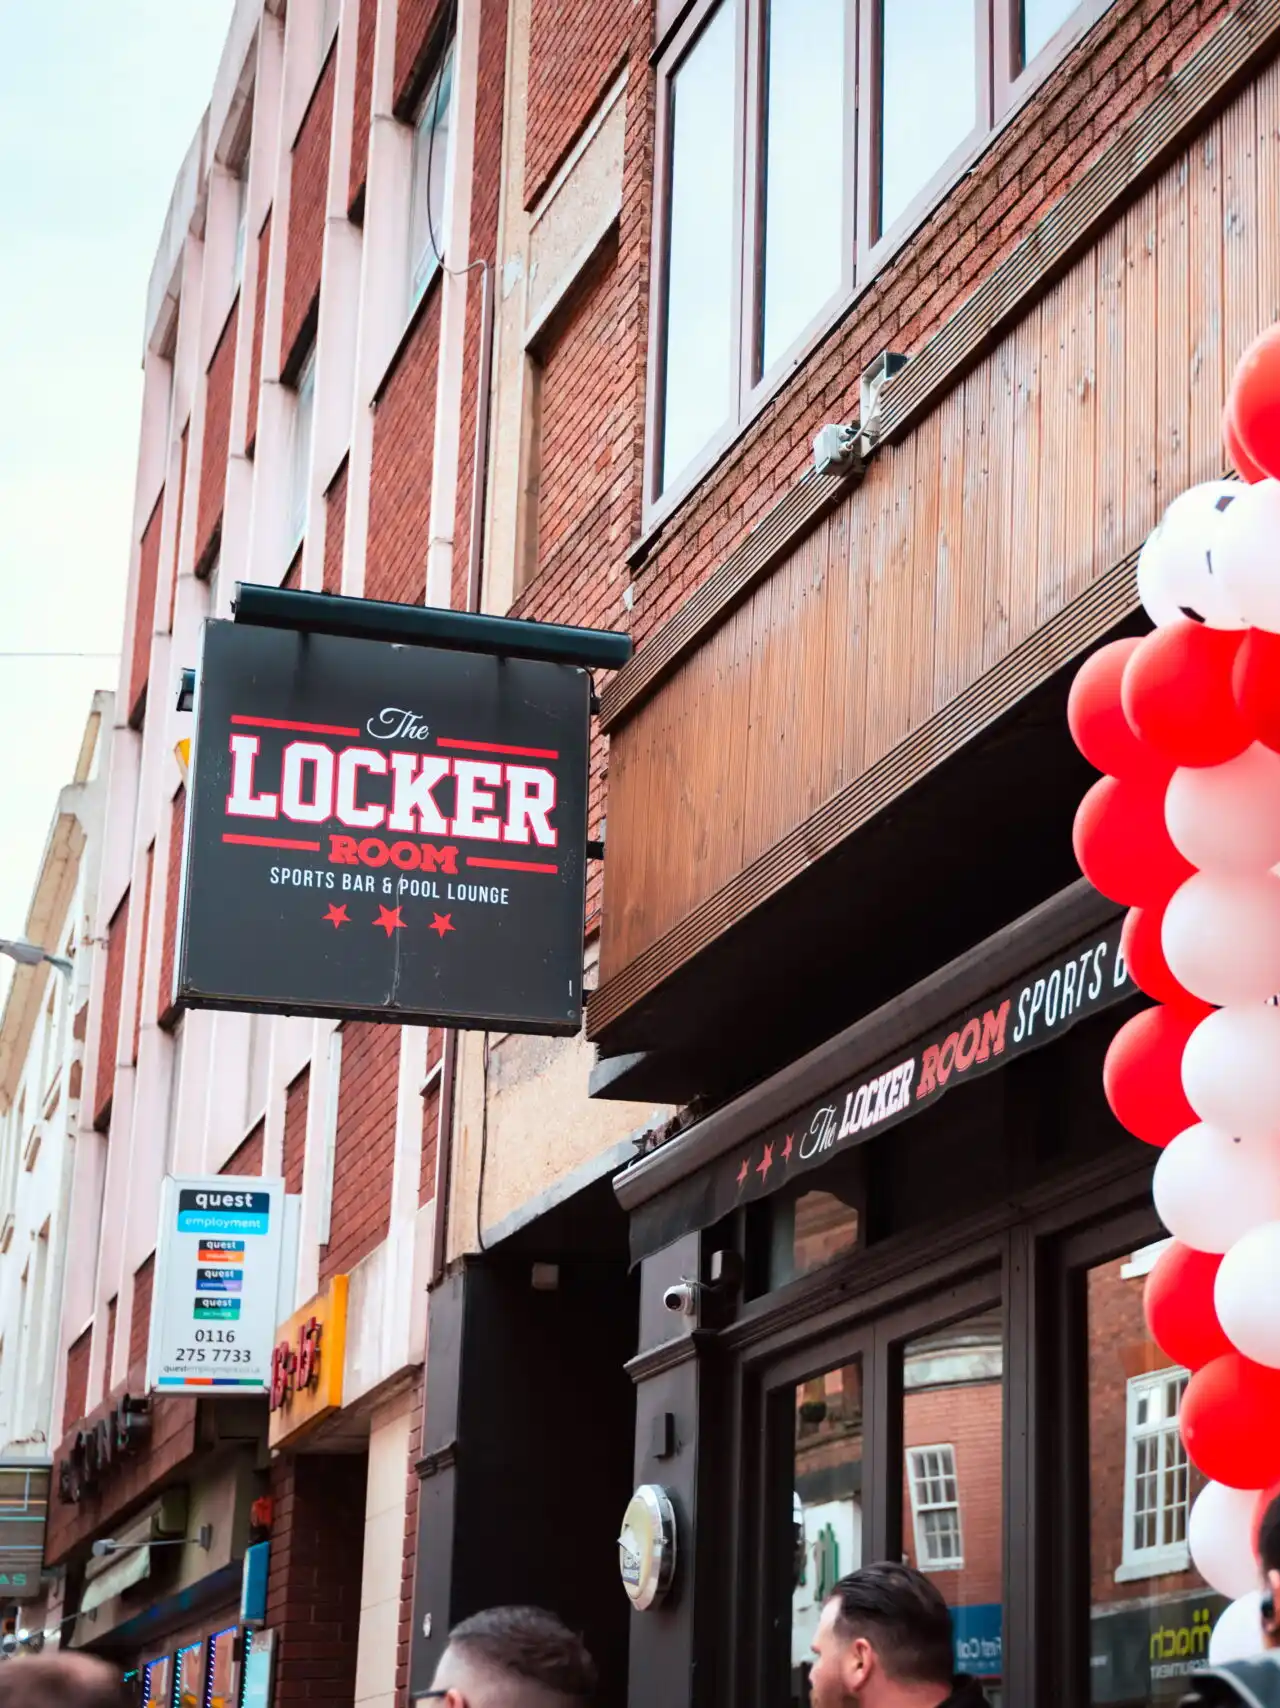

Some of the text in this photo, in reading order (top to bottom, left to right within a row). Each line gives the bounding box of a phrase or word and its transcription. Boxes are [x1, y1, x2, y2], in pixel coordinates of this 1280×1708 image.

[367, 707, 429, 741] The
[225, 734, 558, 848] LOCKER
[328, 834, 459, 875] ROOM
[270, 866, 509, 905] SPORTS BAR & POOL LOUNGE
[799, 1104, 836, 1160] The
[837, 1057, 915, 1141] LOCKER
[916, 999, 1011, 1100] ROOM
[1012, 941, 1107, 1043] SPORTS
[196, 1193, 253, 1209] quest
[185, 1217, 260, 1230] employment
[206, 1240, 236, 1250] quest
[204, 1269, 234, 1279] quest
[202, 1298, 232, 1308] quest
[195, 1329, 235, 1343] 0116
[176, 1348, 251, 1363] 275 7733
